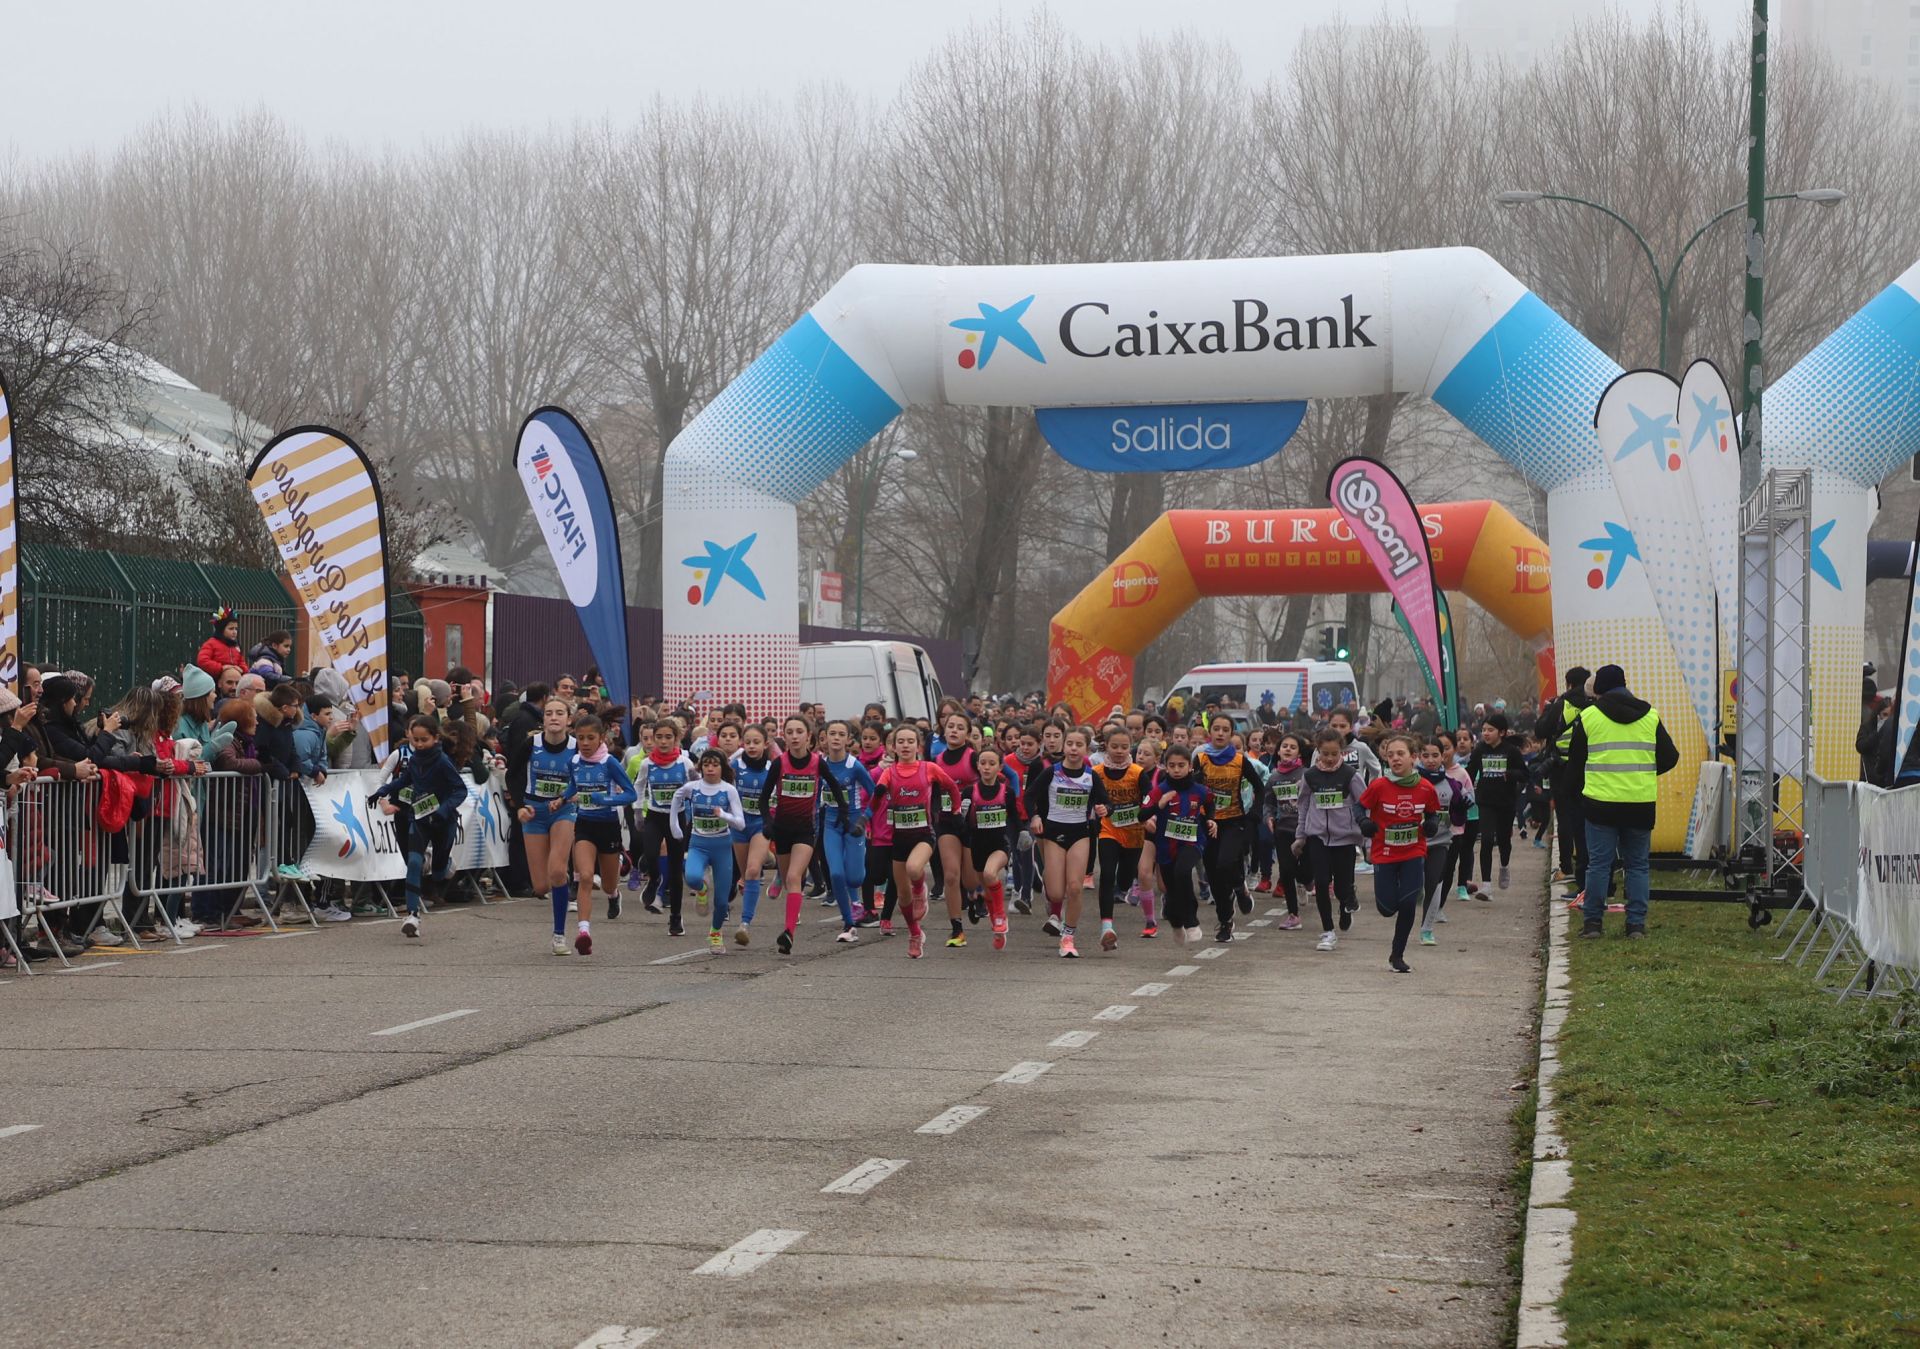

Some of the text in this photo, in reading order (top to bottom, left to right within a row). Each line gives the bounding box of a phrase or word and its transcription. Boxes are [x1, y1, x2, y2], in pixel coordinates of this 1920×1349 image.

[1058, 294, 1377, 358] CaixaBank
[1111, 417, 1232, 454] Salida
[1205, 512, 1444, 546] BURGS
[1206, 549, 1441, 567] AYUNTAMIO
[1516, 561, 1551, 576] deport
[1113, 576, 1159, 590] deportes
[543, 783, 561, 793] 887
[790, 782, 808, 792] 844
[1064, 796, 1083, 806] 858
[1320, 794, 1336, 804] 857
[901, 813, 919, 823] 882
[984, 813, 1001, 823] 931
[702, 820, 720, 830] 834
[1175, 825, 1192, 836] 825
[1394, 831, 1412, 841] 876
